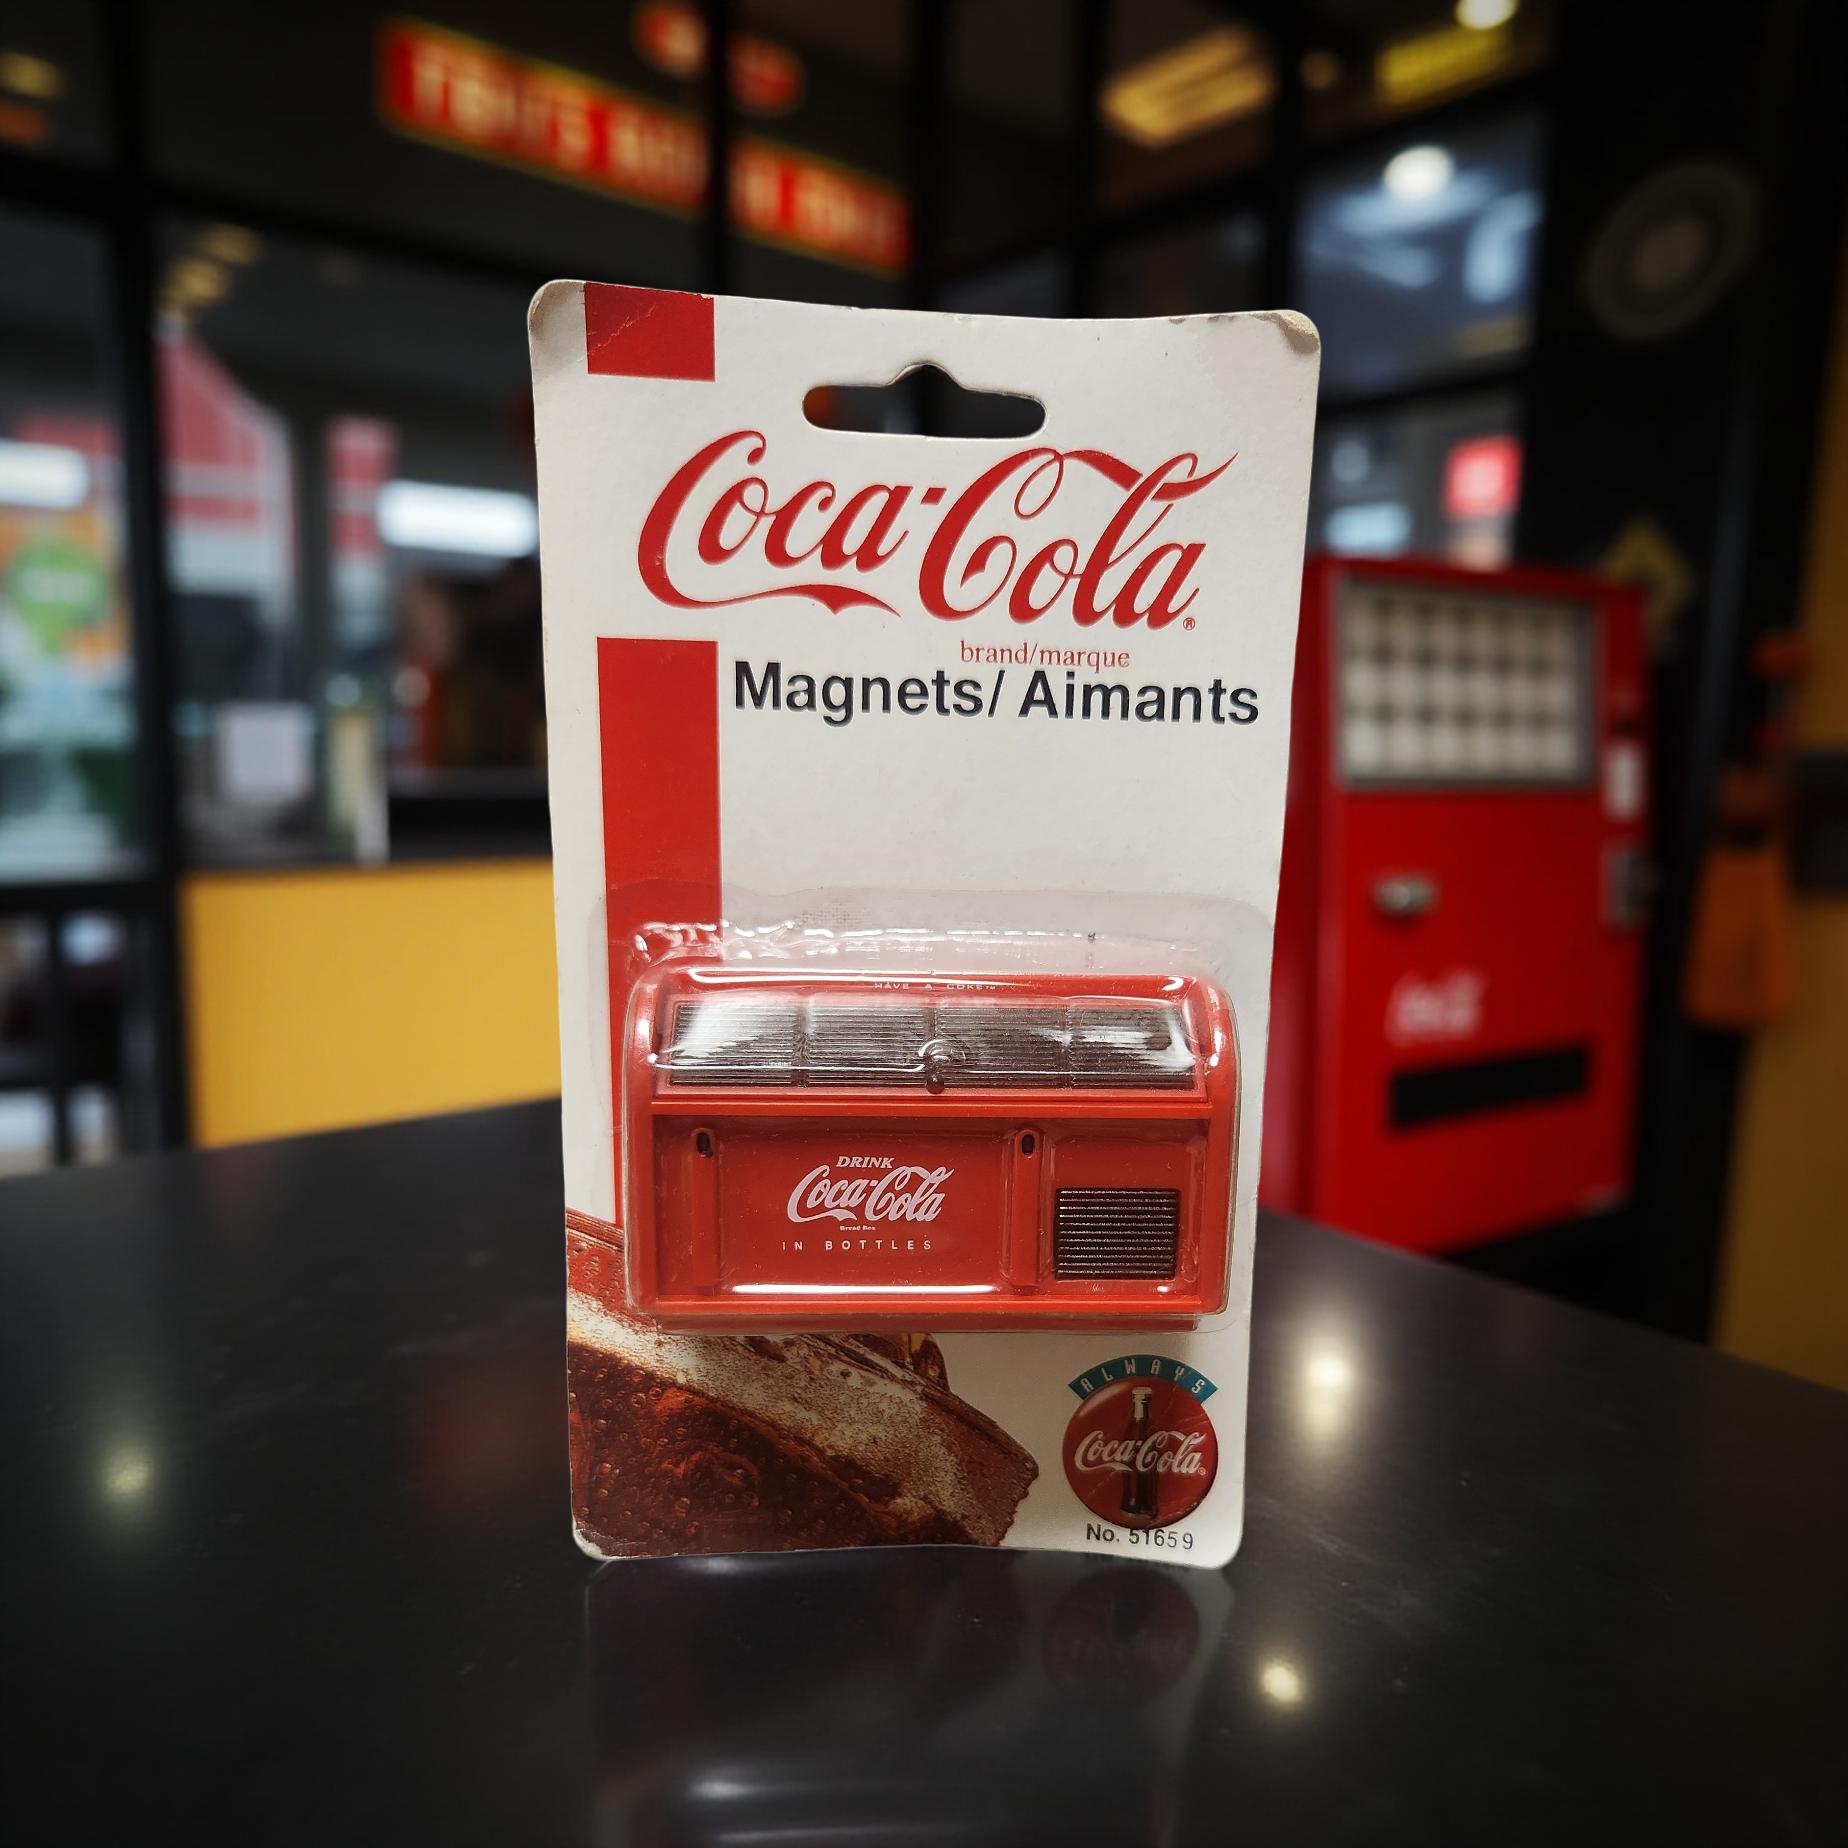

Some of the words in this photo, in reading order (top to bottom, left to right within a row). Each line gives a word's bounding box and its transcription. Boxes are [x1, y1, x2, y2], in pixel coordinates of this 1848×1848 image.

[960, 640, 1131, 674] brand/marque
[735, 661, 1006, 726] Magnets/
[1018, 670, 1259, 725] Aimants
[874, 982, 909, 990] HAVE
[836, 1156, 894, 1169] DRINK
[787, 1165, 955, 1223] Coca-Cola
[782, 1241, 803, 1251] IN
[825, 1240, 932, 1250] BOTTLES
[1079, 1358, 1206, 1395] ALWAYS
[1086, 1523, 1120, 1543] No.
[1129, 1529, 1194, 1550] 51659
